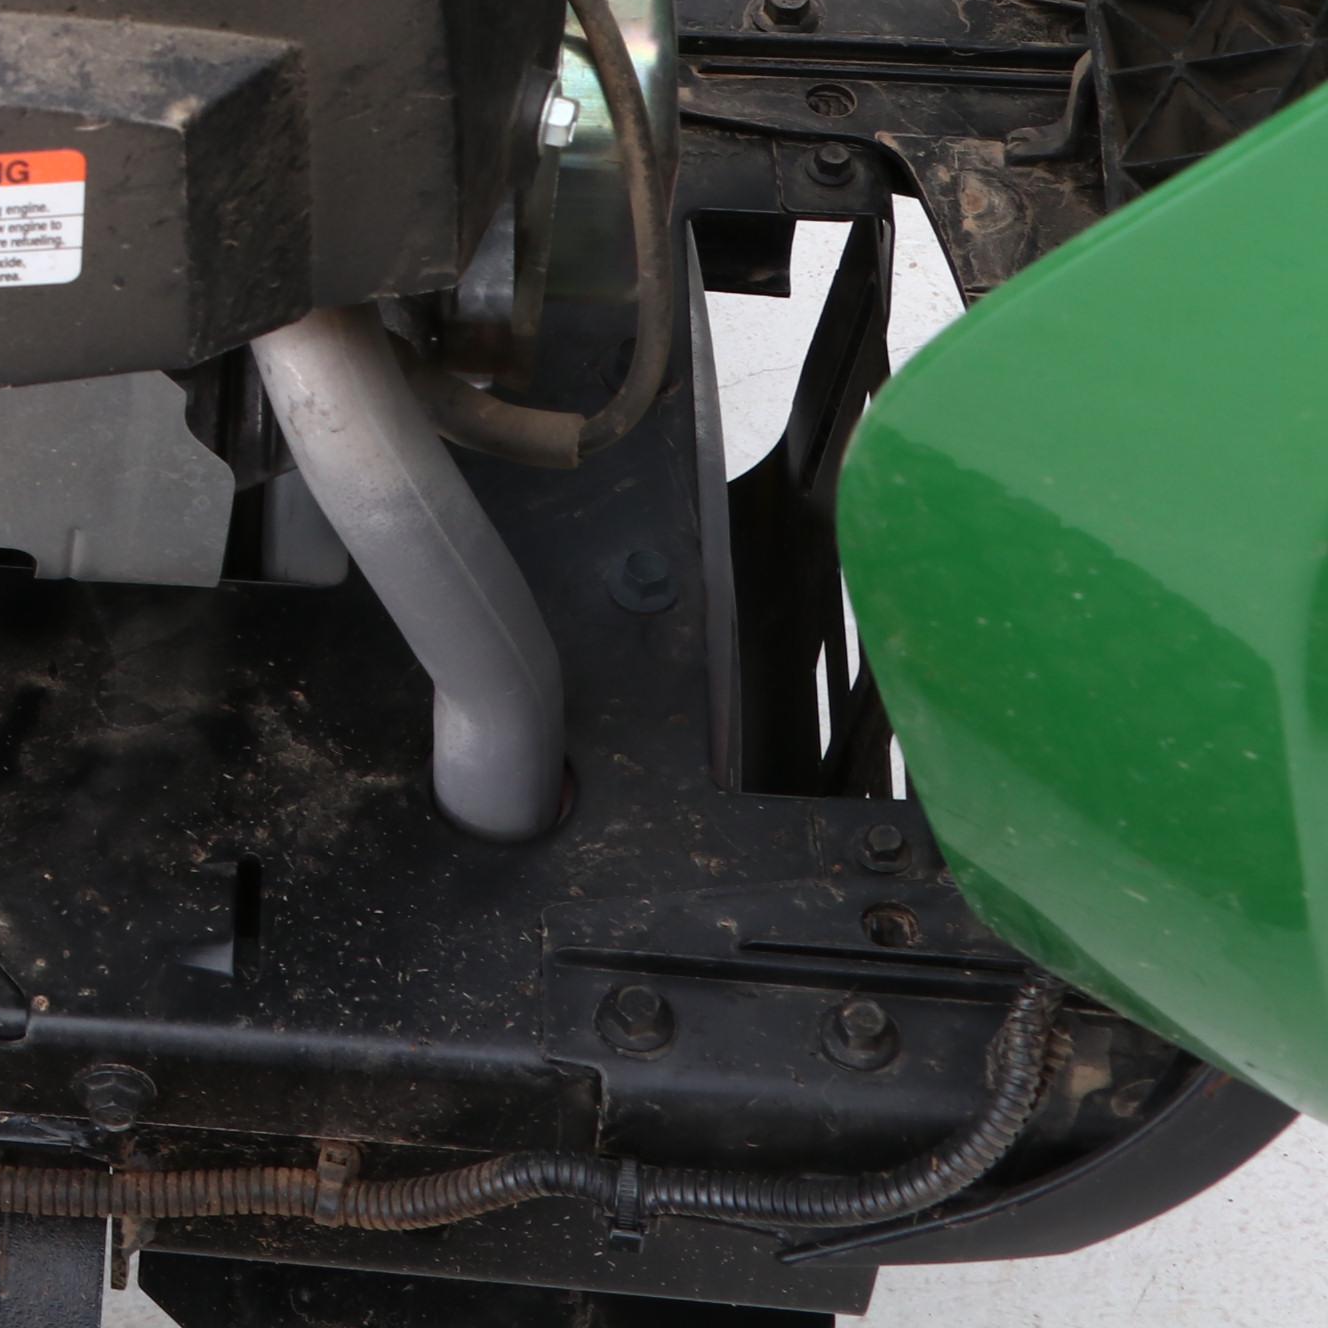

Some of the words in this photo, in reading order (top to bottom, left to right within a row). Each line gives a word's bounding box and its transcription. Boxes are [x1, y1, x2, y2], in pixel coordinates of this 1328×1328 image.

[6, 202, 50, 216] engine.
[8, 221, 47, 236] engine
[50, 220, 62, 231] to
[11, 234, 64, 249] refueling.
